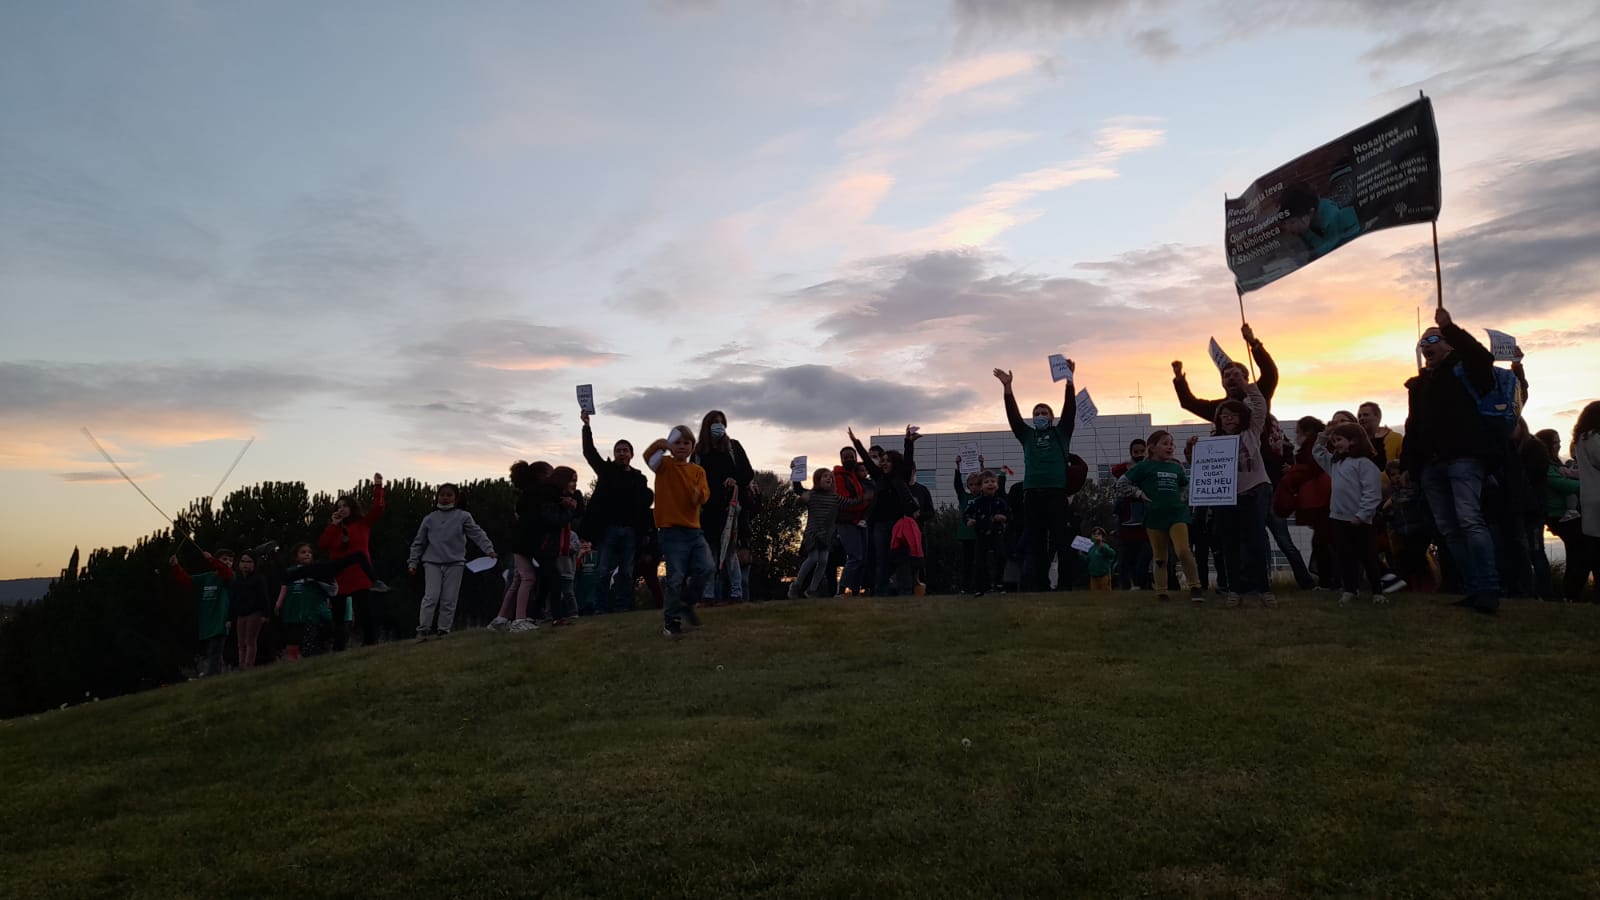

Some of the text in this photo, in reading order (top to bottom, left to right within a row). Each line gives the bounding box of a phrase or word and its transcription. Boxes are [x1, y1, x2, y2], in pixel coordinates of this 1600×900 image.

[1353, 127, 1398, 154] Nosaltres
[1243, 226, 1281, 249] biblioteca
[1195, 456, 1234, 465] AJUNTAMENT
[1211, 463, 1226, 471] SANT
[1195, 477, 1232, 487] ENS HEU
[1196, 486, 1230, 495] FALLAT!
